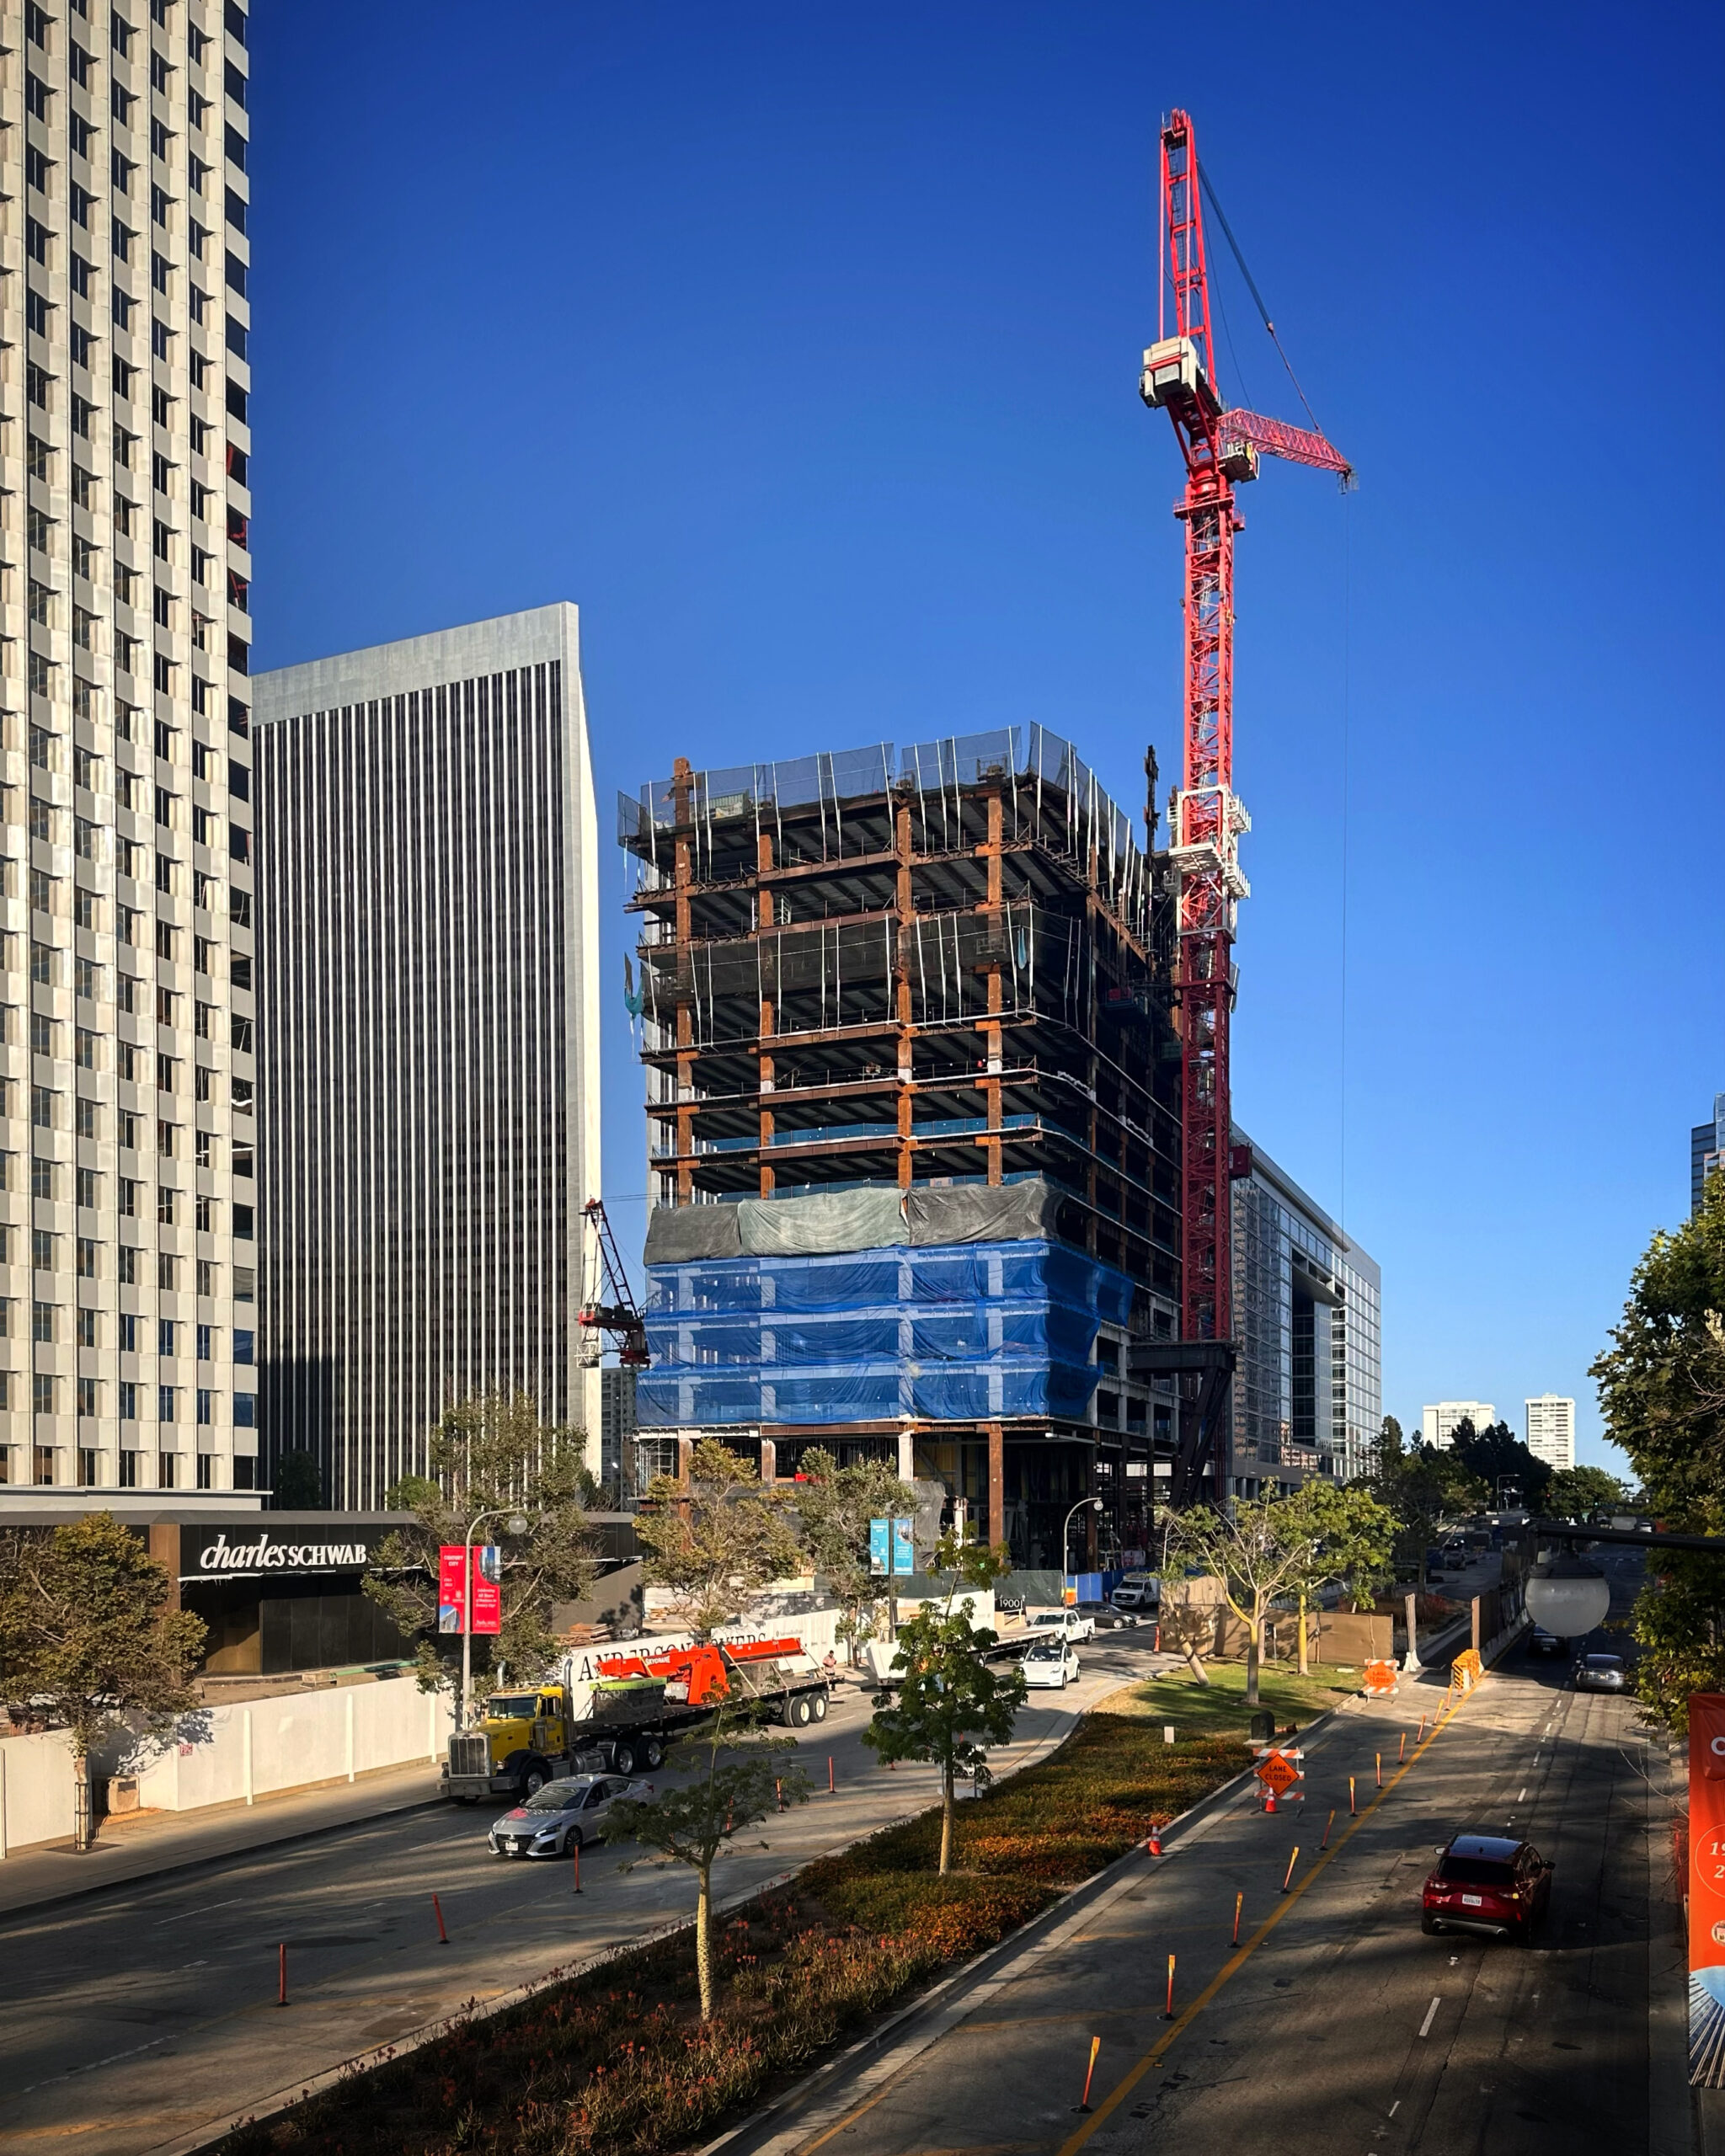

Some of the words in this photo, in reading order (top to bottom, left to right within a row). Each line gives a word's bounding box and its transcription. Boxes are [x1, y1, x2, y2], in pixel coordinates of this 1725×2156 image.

[200, 1534, 288, 1569] charles
[287, 1544, 367, 1566] SCHWAB
[1000, 1598, 1020, 1608] 1900
[1264, 1774, 1292, 1782] CLOSED
